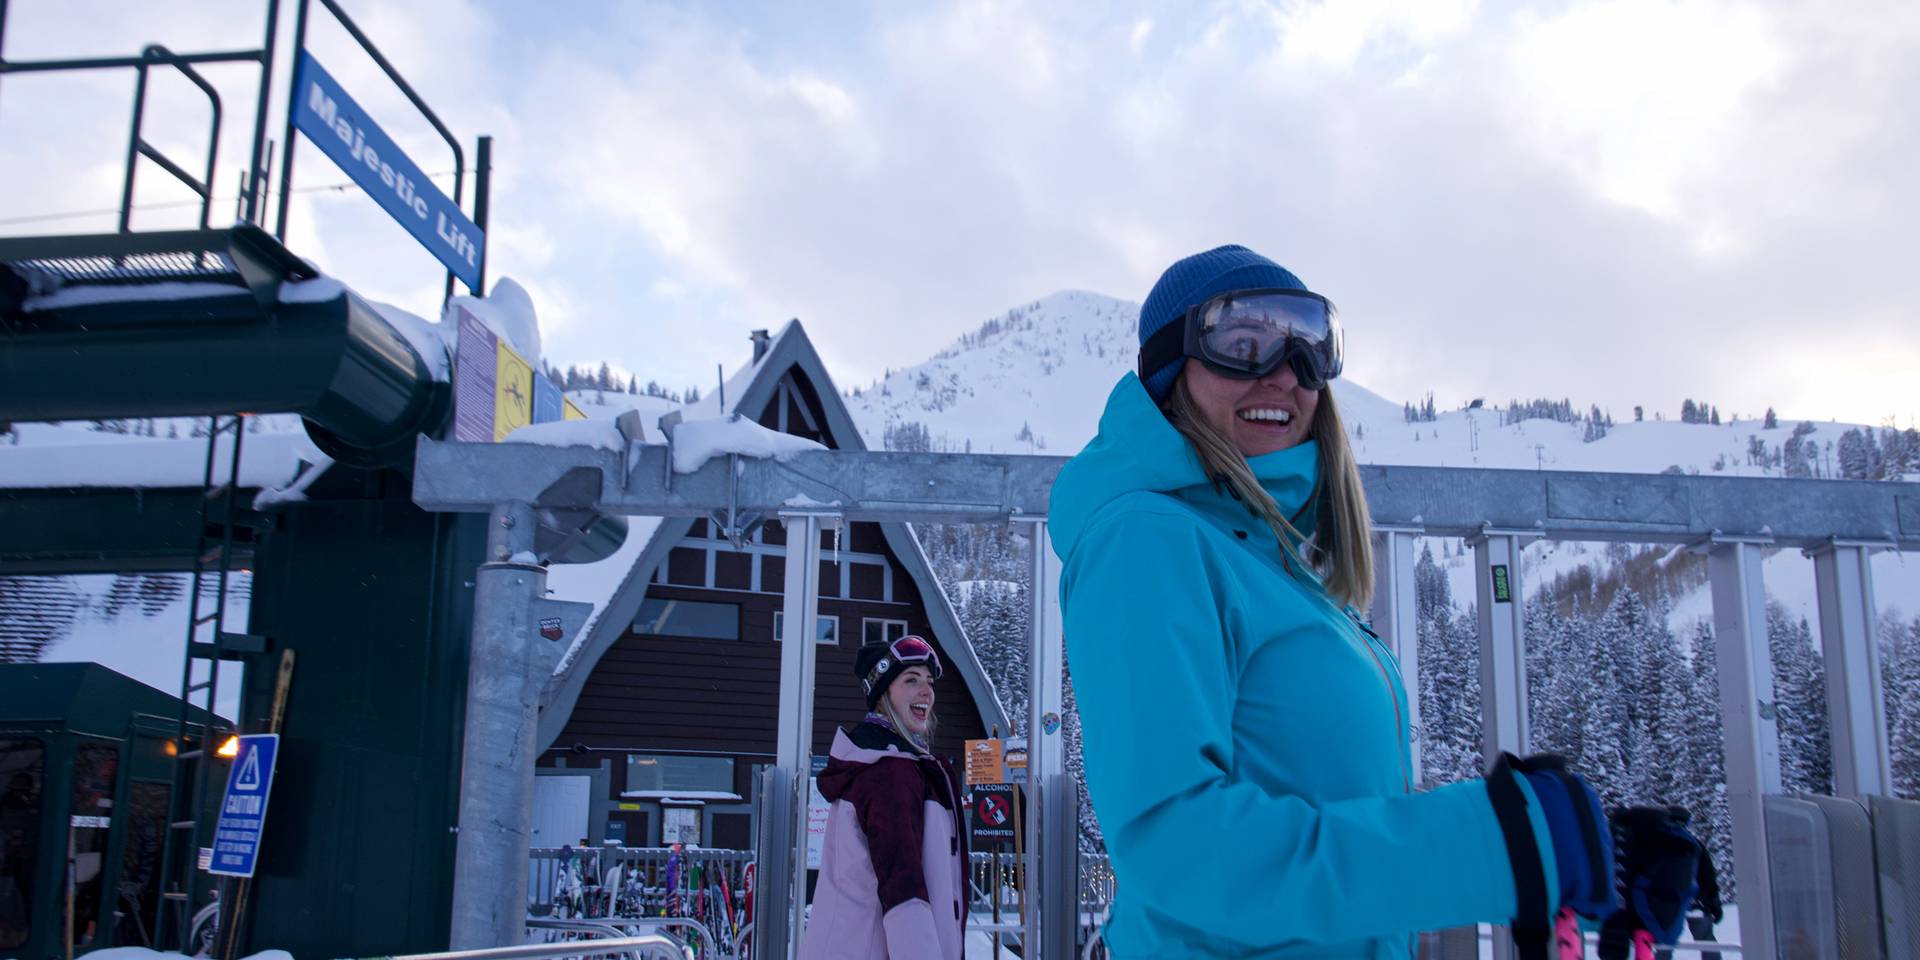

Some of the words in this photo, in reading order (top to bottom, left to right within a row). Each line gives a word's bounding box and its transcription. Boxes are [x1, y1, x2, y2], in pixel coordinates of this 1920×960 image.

[309, 82, 429, 220] Majestic
[436, 210, 477, 267] Lift
[975, 784, 1013, 792] ALCOHOL
[225, 795, 261, 814] CAUTION
[974, 828, 1014, 836] PROHIBITED
